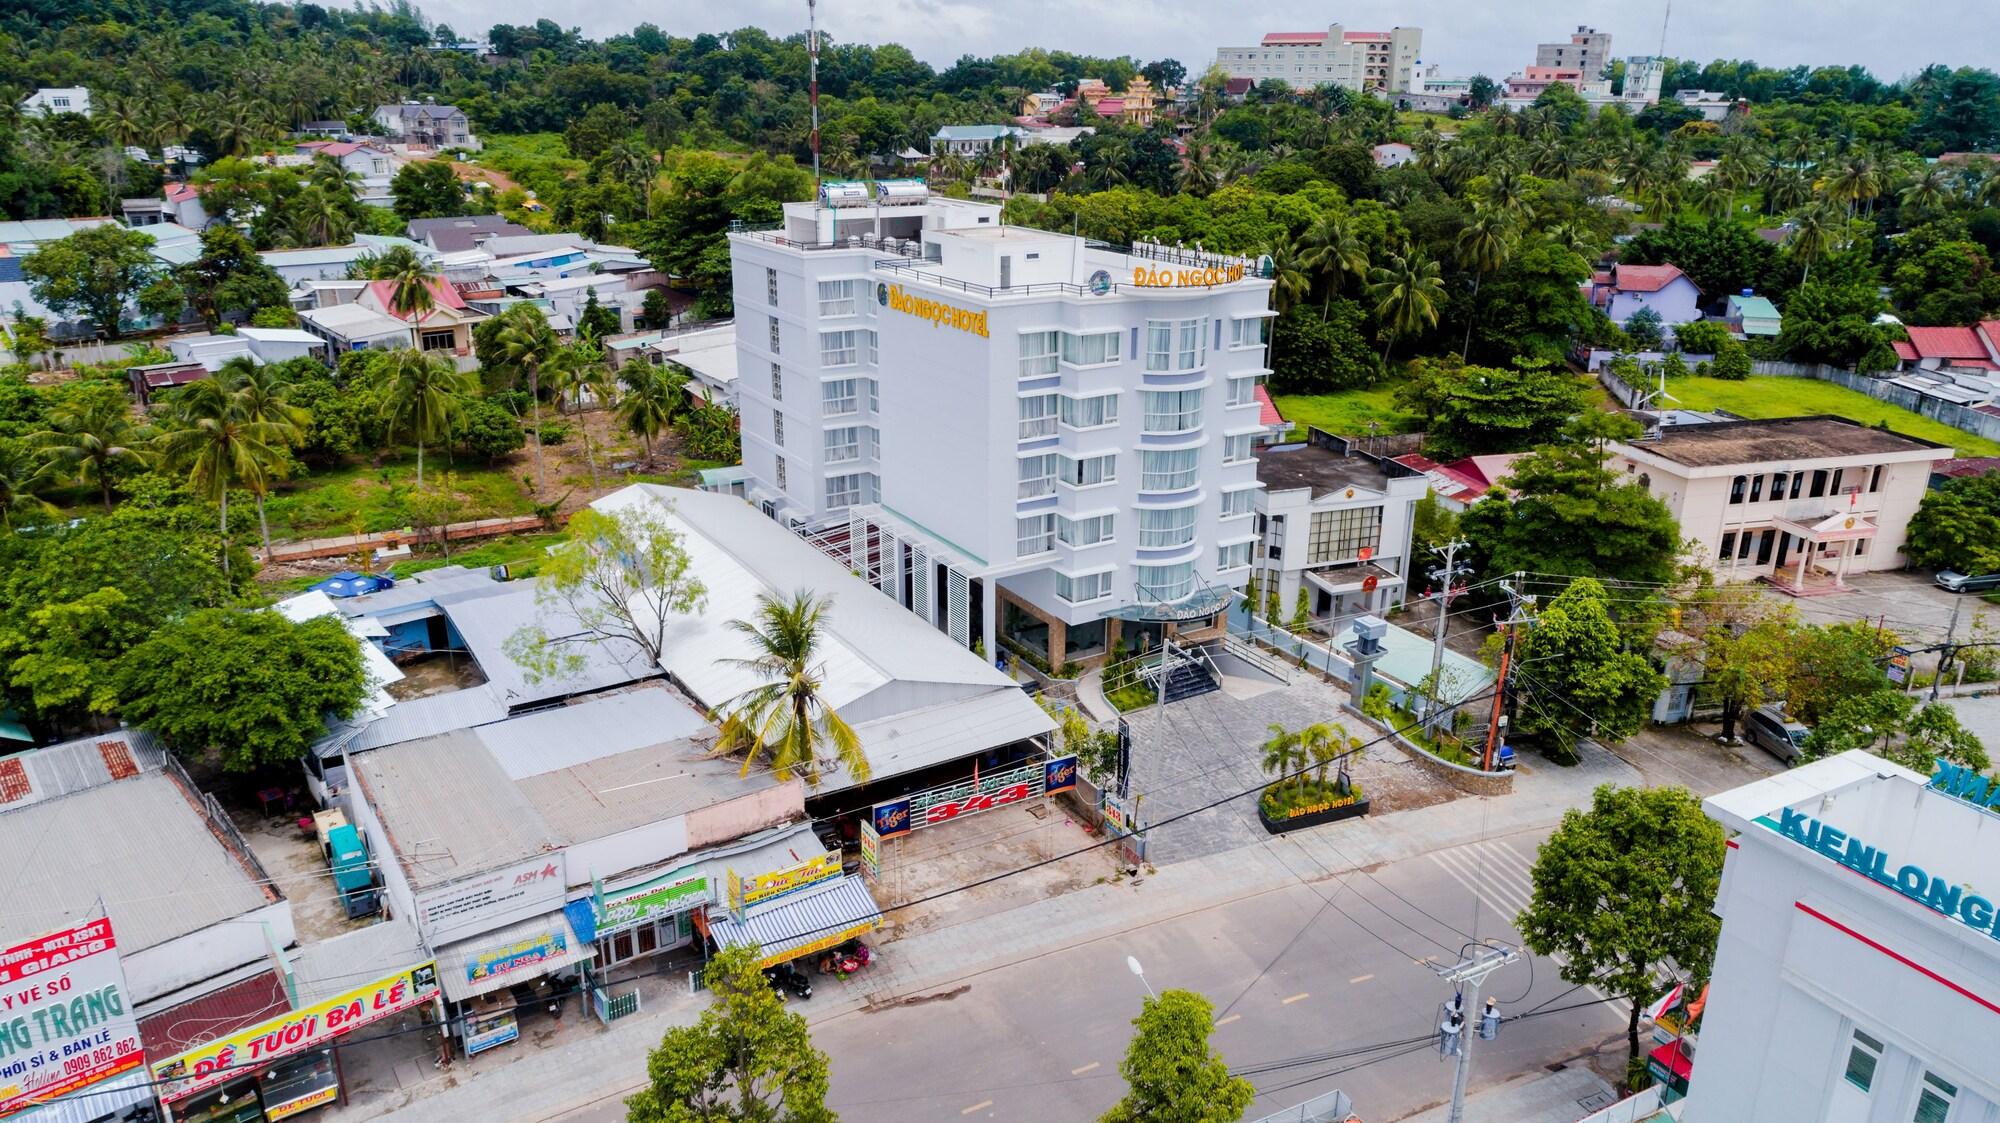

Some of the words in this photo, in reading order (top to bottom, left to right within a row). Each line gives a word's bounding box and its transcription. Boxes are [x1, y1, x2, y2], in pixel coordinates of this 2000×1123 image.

[1134, 263, 1173, 287] ĐẢO
[1178, 267, 1225, 291] NGỌC
[914, 297, 951, 328] NGỌC
[952, 307, 990, 338] HOTEL
[1047, 764, 1076, 784] Tiger
[877, 808, 909, 830] Tiger
[926, 783, 1030, 822] 343
[1331, 794, 1354, 807] HOTEL
[1779, 806, 2000, 940] KIENLONG
[21, 940, 107, 975] GIANG
[18, 984, 42, 1005] VÉ
[46, 971, 72, 995] SỐ
[32, 984, 124, 1043] TRANG
[248, 1017, 317, 1060] TƯƠI
[326, 1000, 363, 1029] BA
[0, 1059, 27, 1078] HỐI
[49, 1050, 59, 1061] &
[63, 1038, 92, 1057] BÁN
[95, 1027, 111, 1044] LẺ
[64, 1054, 91, 1075] 0909
[93, 1045, 114, 1064] 862
[116, 1037, 137, 1056] 862
